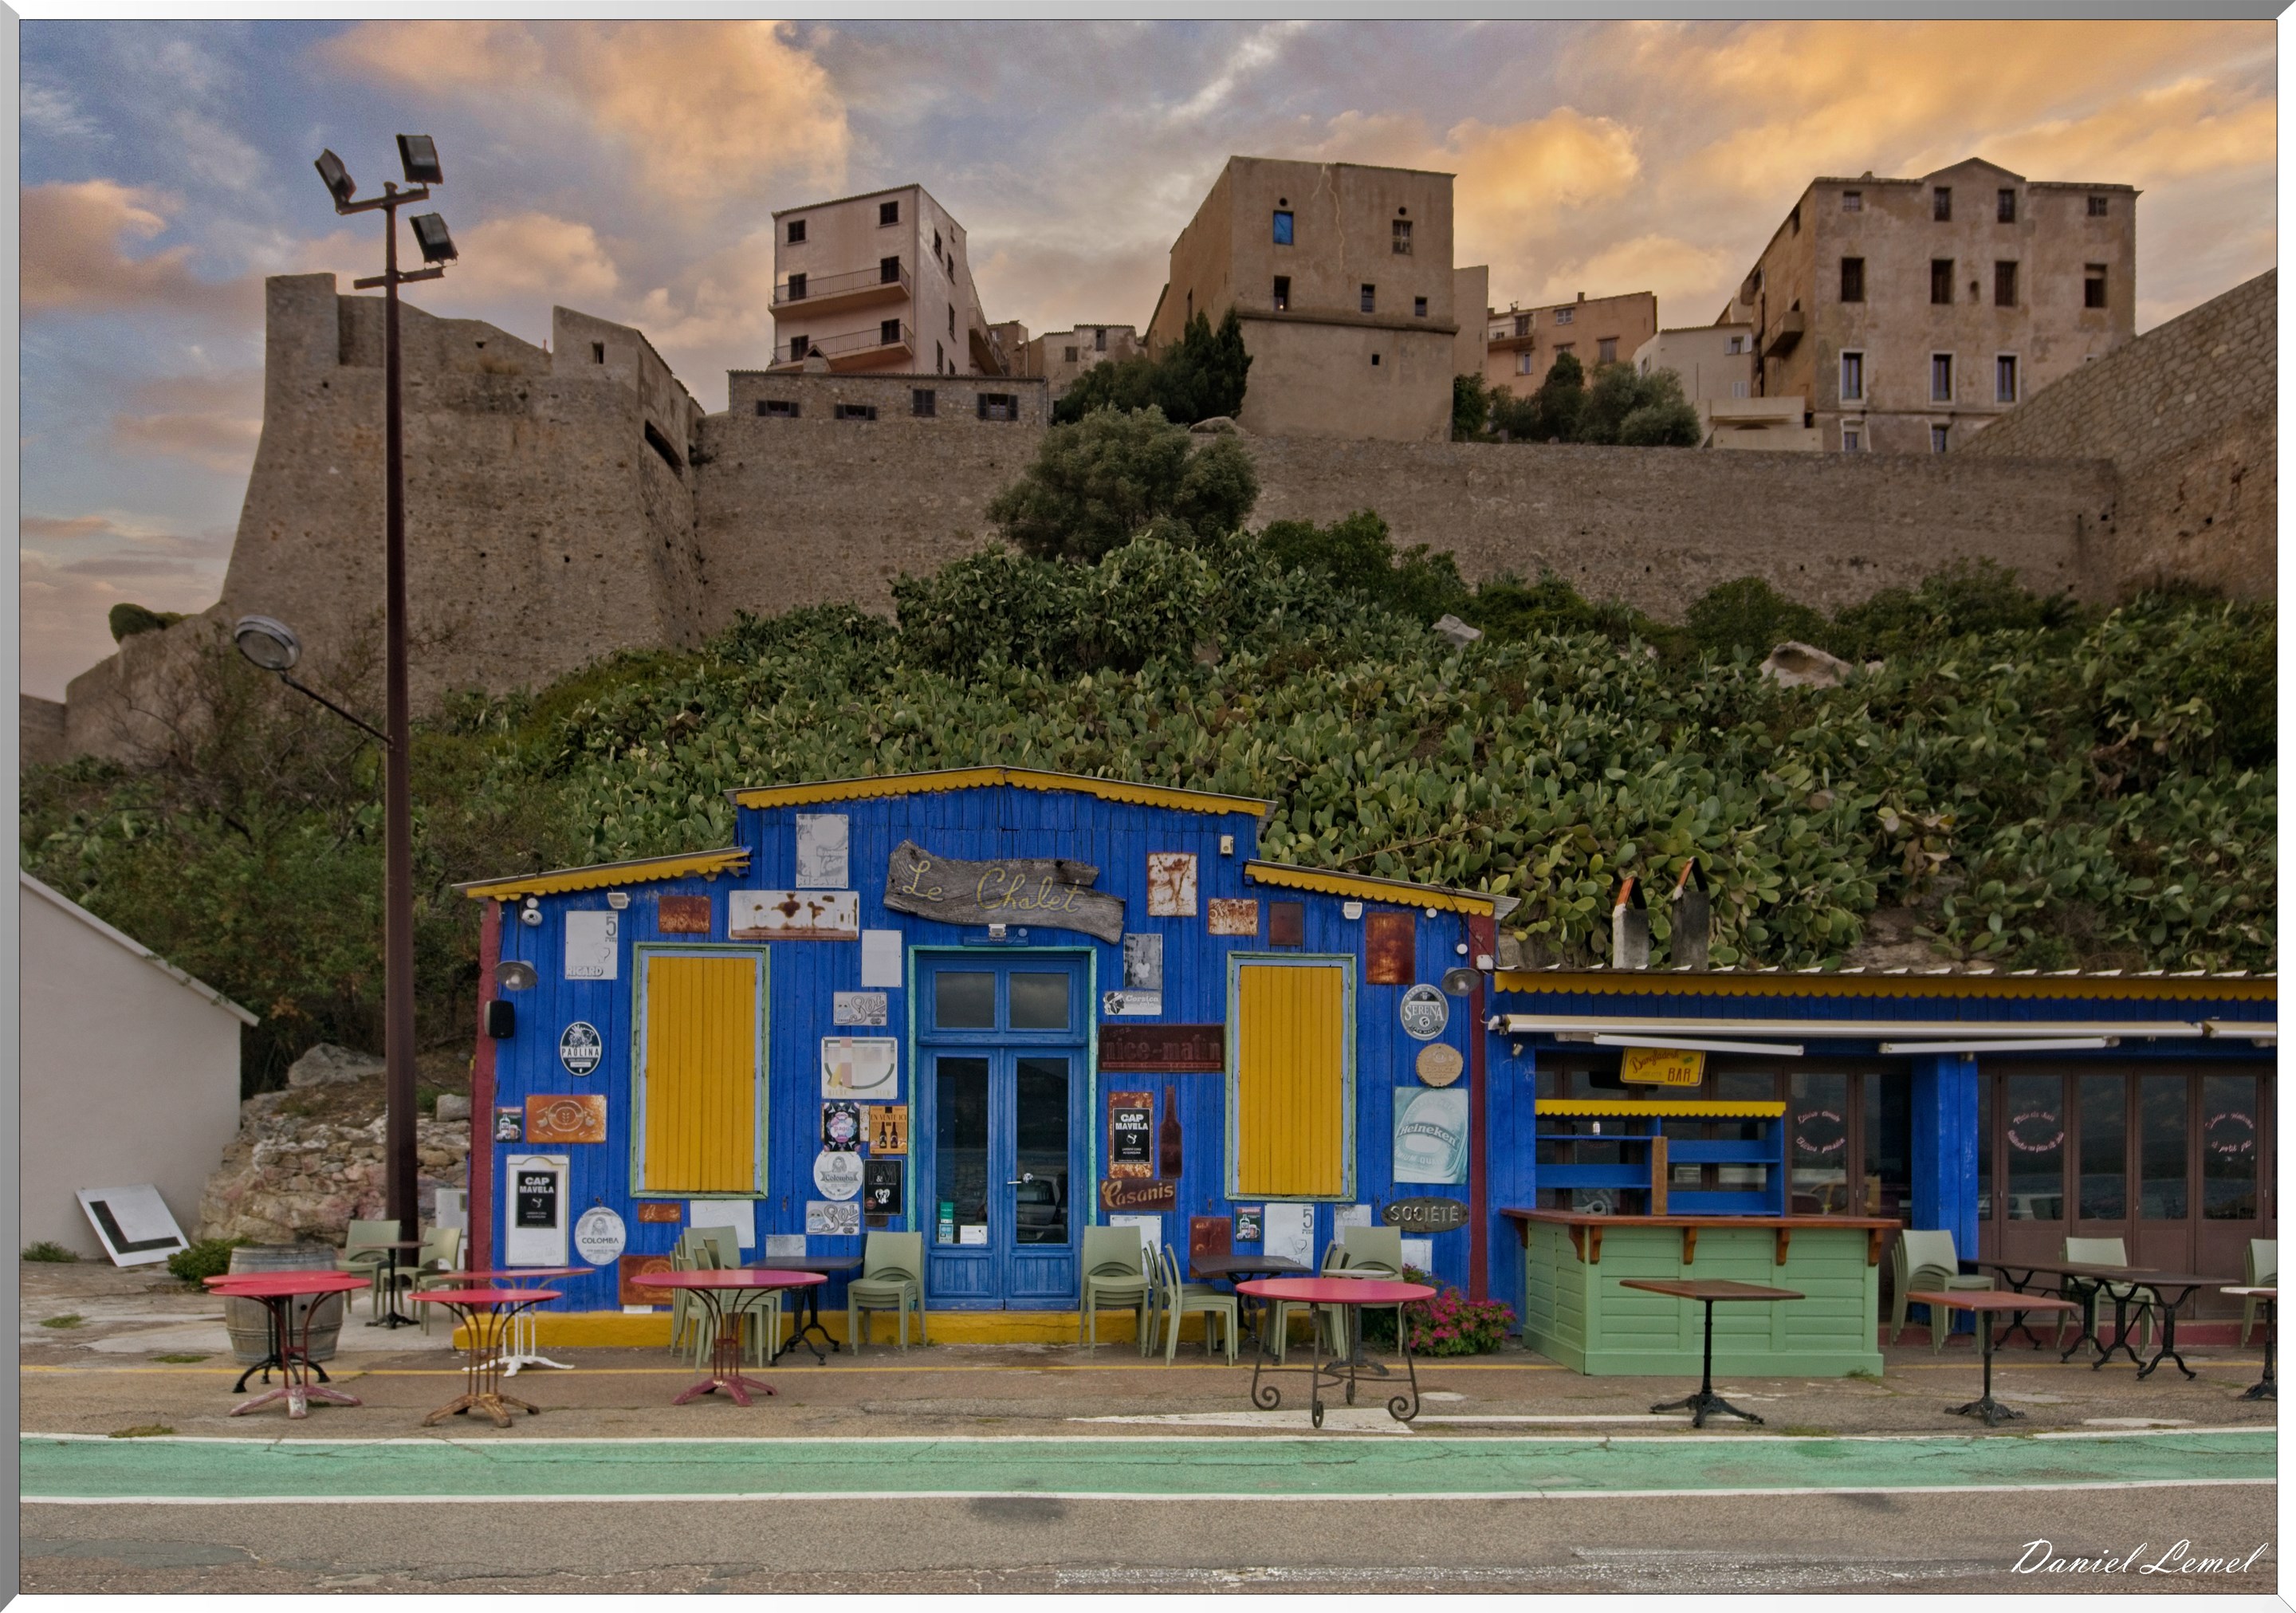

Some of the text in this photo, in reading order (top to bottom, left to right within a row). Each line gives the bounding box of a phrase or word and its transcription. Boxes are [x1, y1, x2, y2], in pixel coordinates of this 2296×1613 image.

[902, 860, 1086, 913] Le Chalet
[606, 916, 617, 937] 5
[1404, 1004, 1445, 1021] SERENA
[561, 1048, 600, 1056] PAOLINA
[1668, 1067, 1691, 1083] BAR
[1120, 1114, 1145, 1123] CAP
[1399, 1123, 1458, 1147] Heineken
[525, 1177, 551, 1186] CAP
[824, 1173, 854, 1182] Colomba
[519, 1186, 555, 1194] MAVELA
[1101, 1180, 1174, 1208] Casanis
[1303, 1209, 1314, 1229] 5
